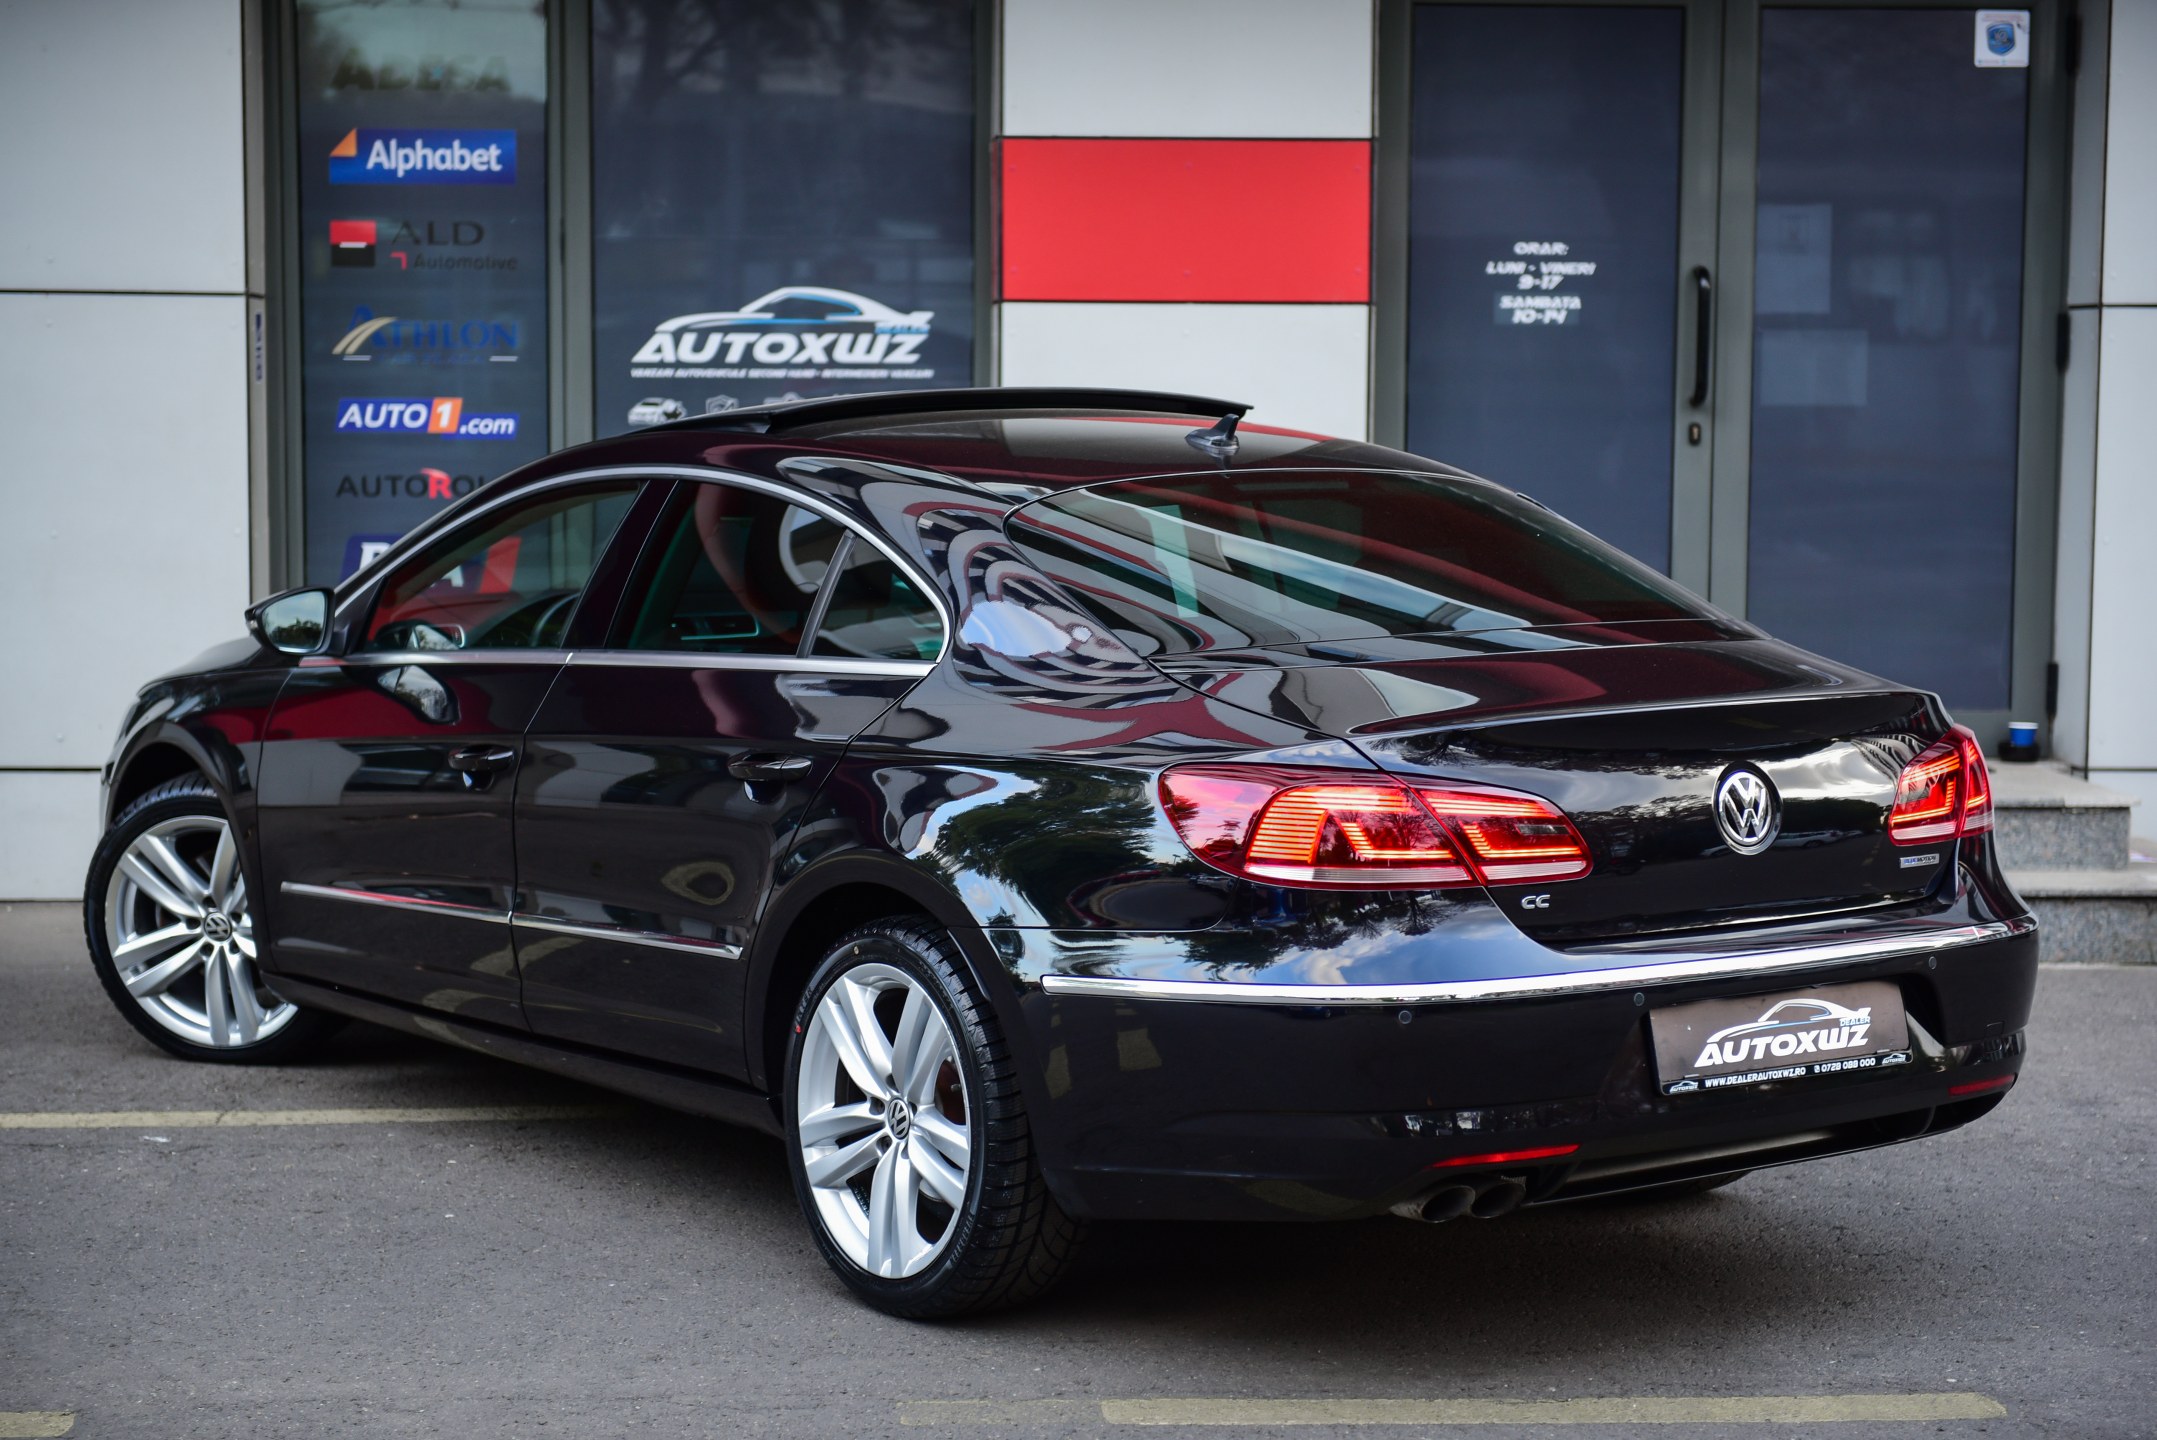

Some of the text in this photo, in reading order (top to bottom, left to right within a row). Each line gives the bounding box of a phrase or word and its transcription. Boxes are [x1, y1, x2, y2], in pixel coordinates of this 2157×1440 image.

[366, 138, 503, 178] Alphabet
[391, 220, 486, 246] ALD
[413, 254, 518, 270] Automotive
[347, 304, 519, 349] ATHLON
[631, 332, 930, 364] AUTOXWZ
[1521, 894, 1551, 910] CC
[1839, 1015, 1871, 1028] DEALER
[1694, 1024, 1871, 1068] AUTOXWZ
[1705, 1067, 1807, 1088] WWW.DEALERAUTOXWZ.RO
[1859, 1058, 1876, 1067] 000
